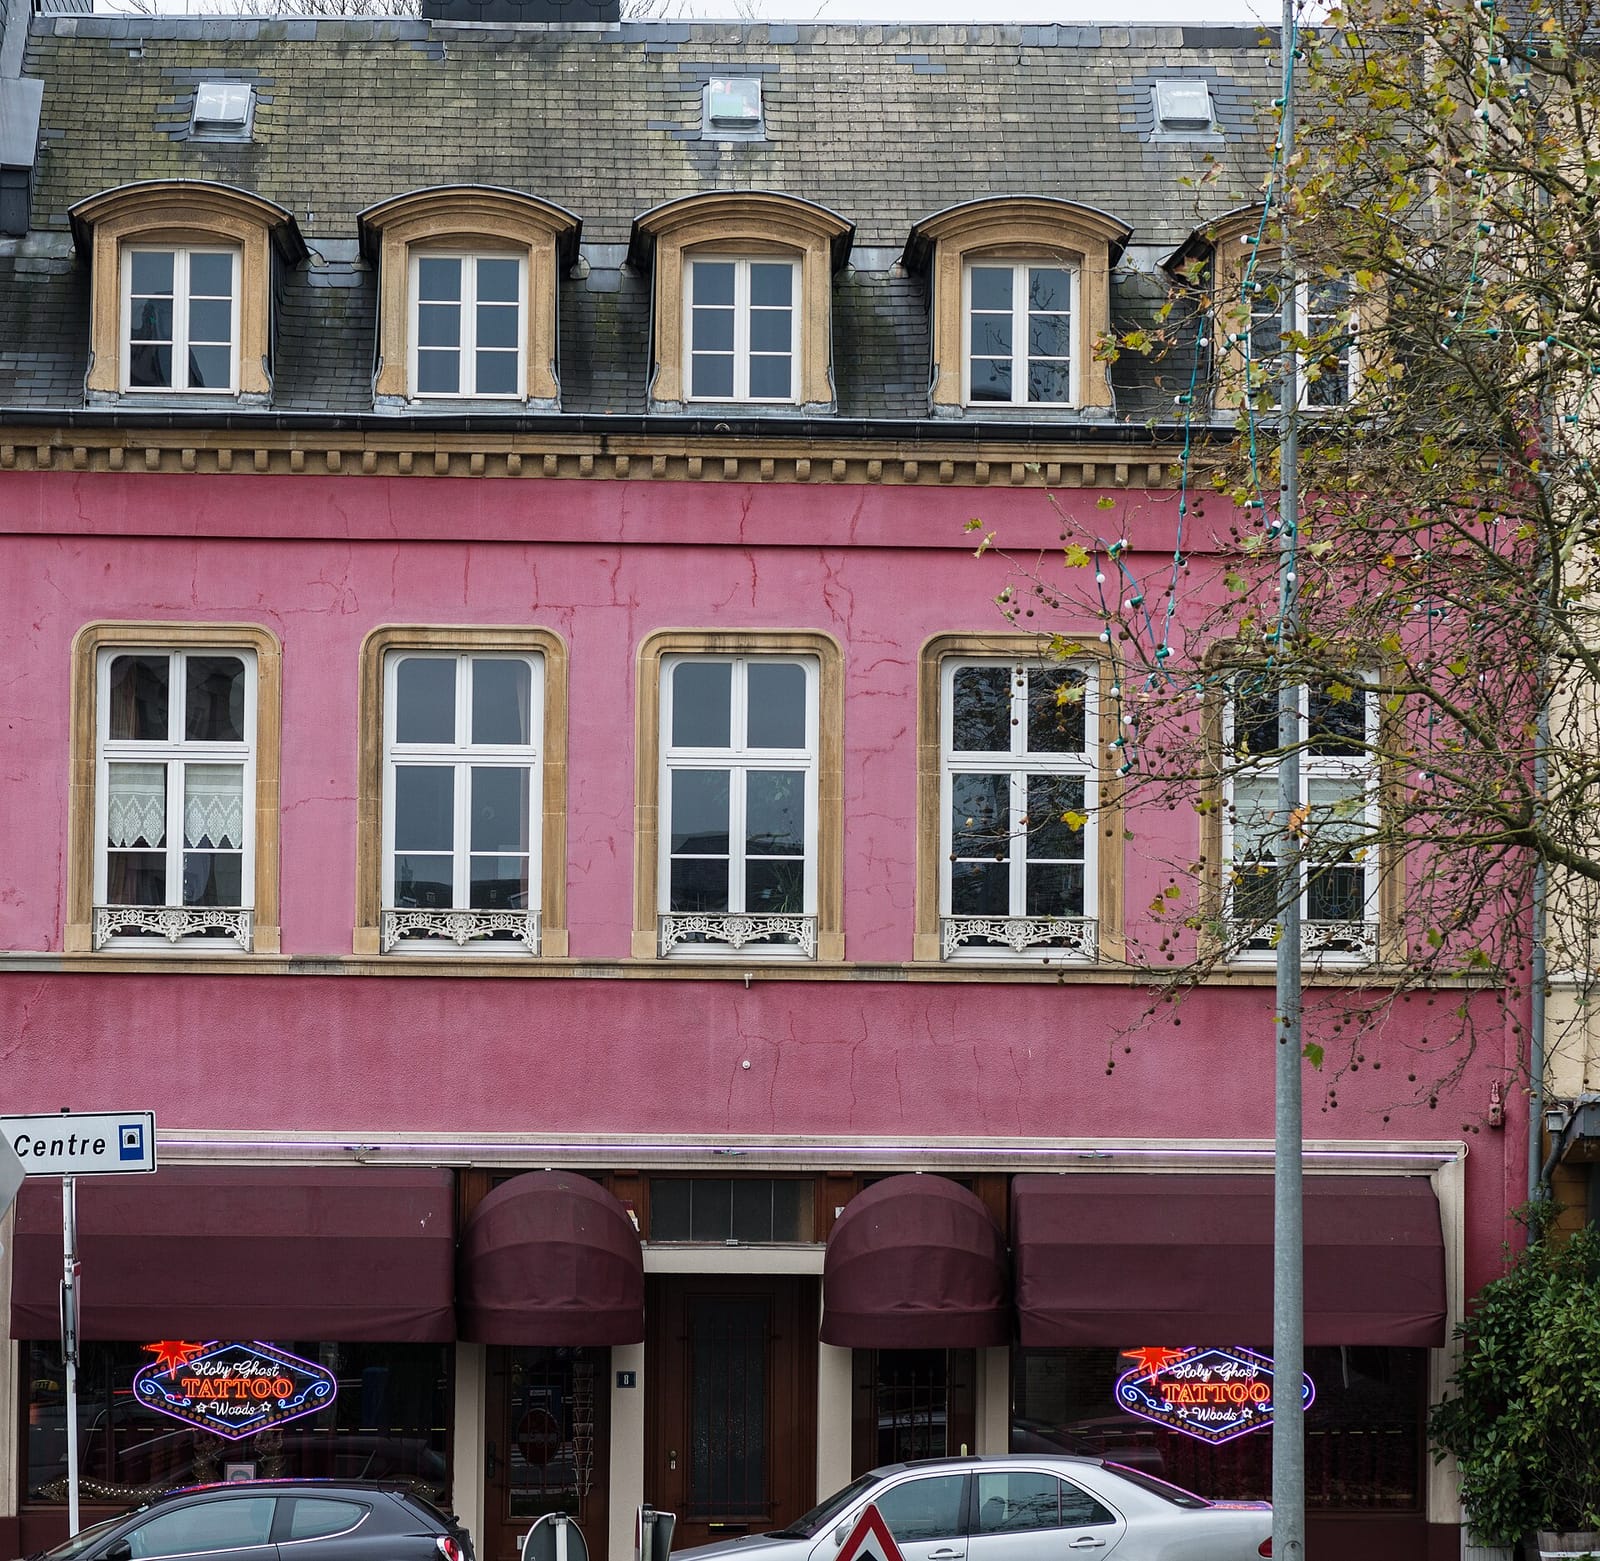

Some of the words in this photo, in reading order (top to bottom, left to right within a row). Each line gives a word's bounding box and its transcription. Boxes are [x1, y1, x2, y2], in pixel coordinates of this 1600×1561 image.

[14, 1133, 106, 1158] Centre
[191, 1360, 232, 1379] Holy
[233, 1359, 280, 1379] Ghost
[1173, 1362, 1212, 1383] Holy
[1213, 1362, 1260, 1382] Ghost
[181, 1378, 293, 1399] TATTOO
[1161, 1382, 1271, 1403] TATTOO
[209, 1401, 256, 1416] Woods
[1191, 1406, 1238, 1421] Woods
